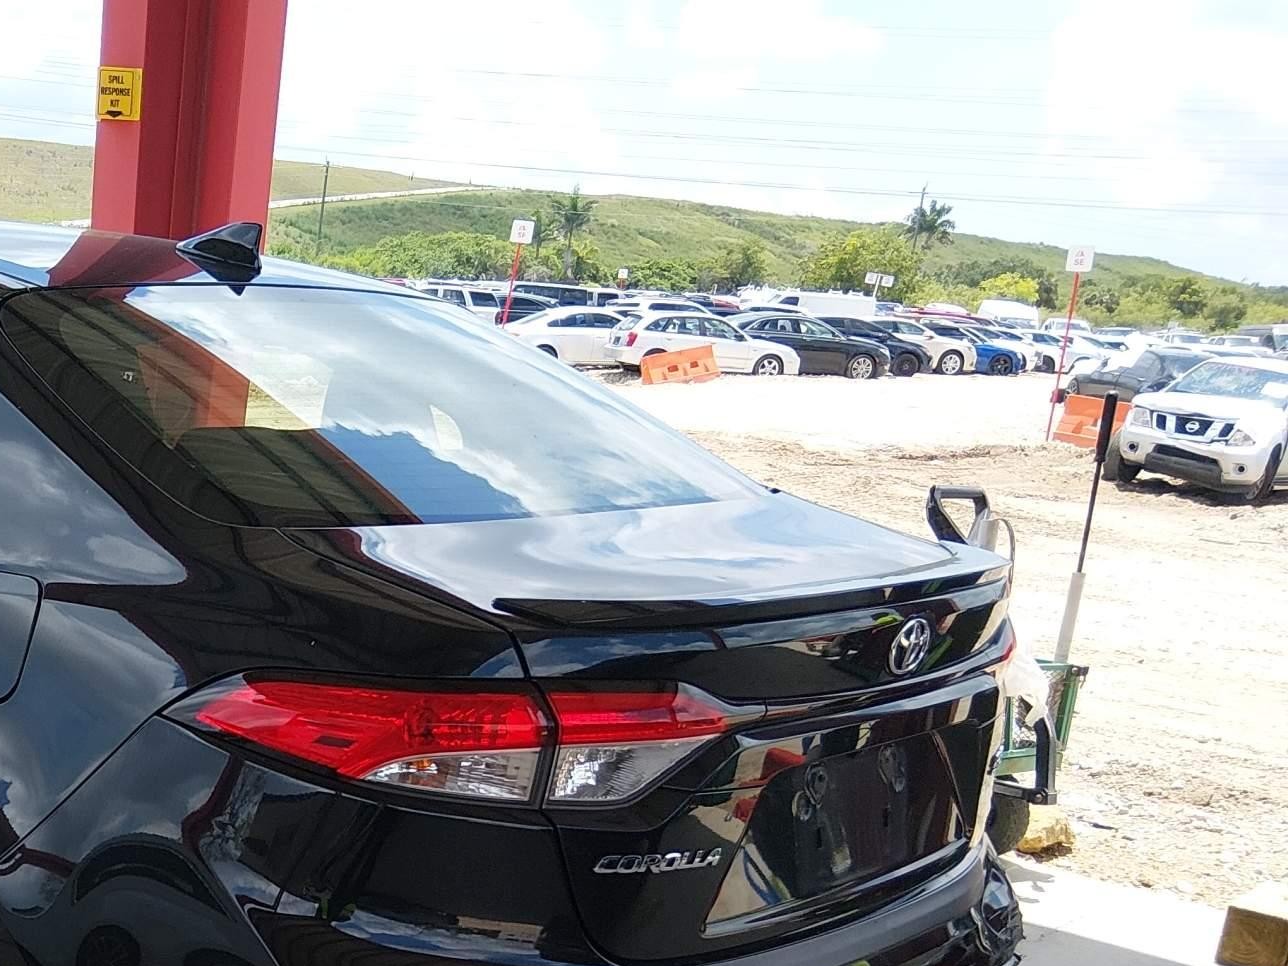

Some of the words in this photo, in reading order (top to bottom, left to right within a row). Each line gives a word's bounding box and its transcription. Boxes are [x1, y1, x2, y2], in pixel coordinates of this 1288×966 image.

[108, 75, 125, 84] SPILL
[101, 87, 130, 96] RESPONSE
[110, 99, 120, 107] KIT
[592, 847, 722, 874] COROLLA
